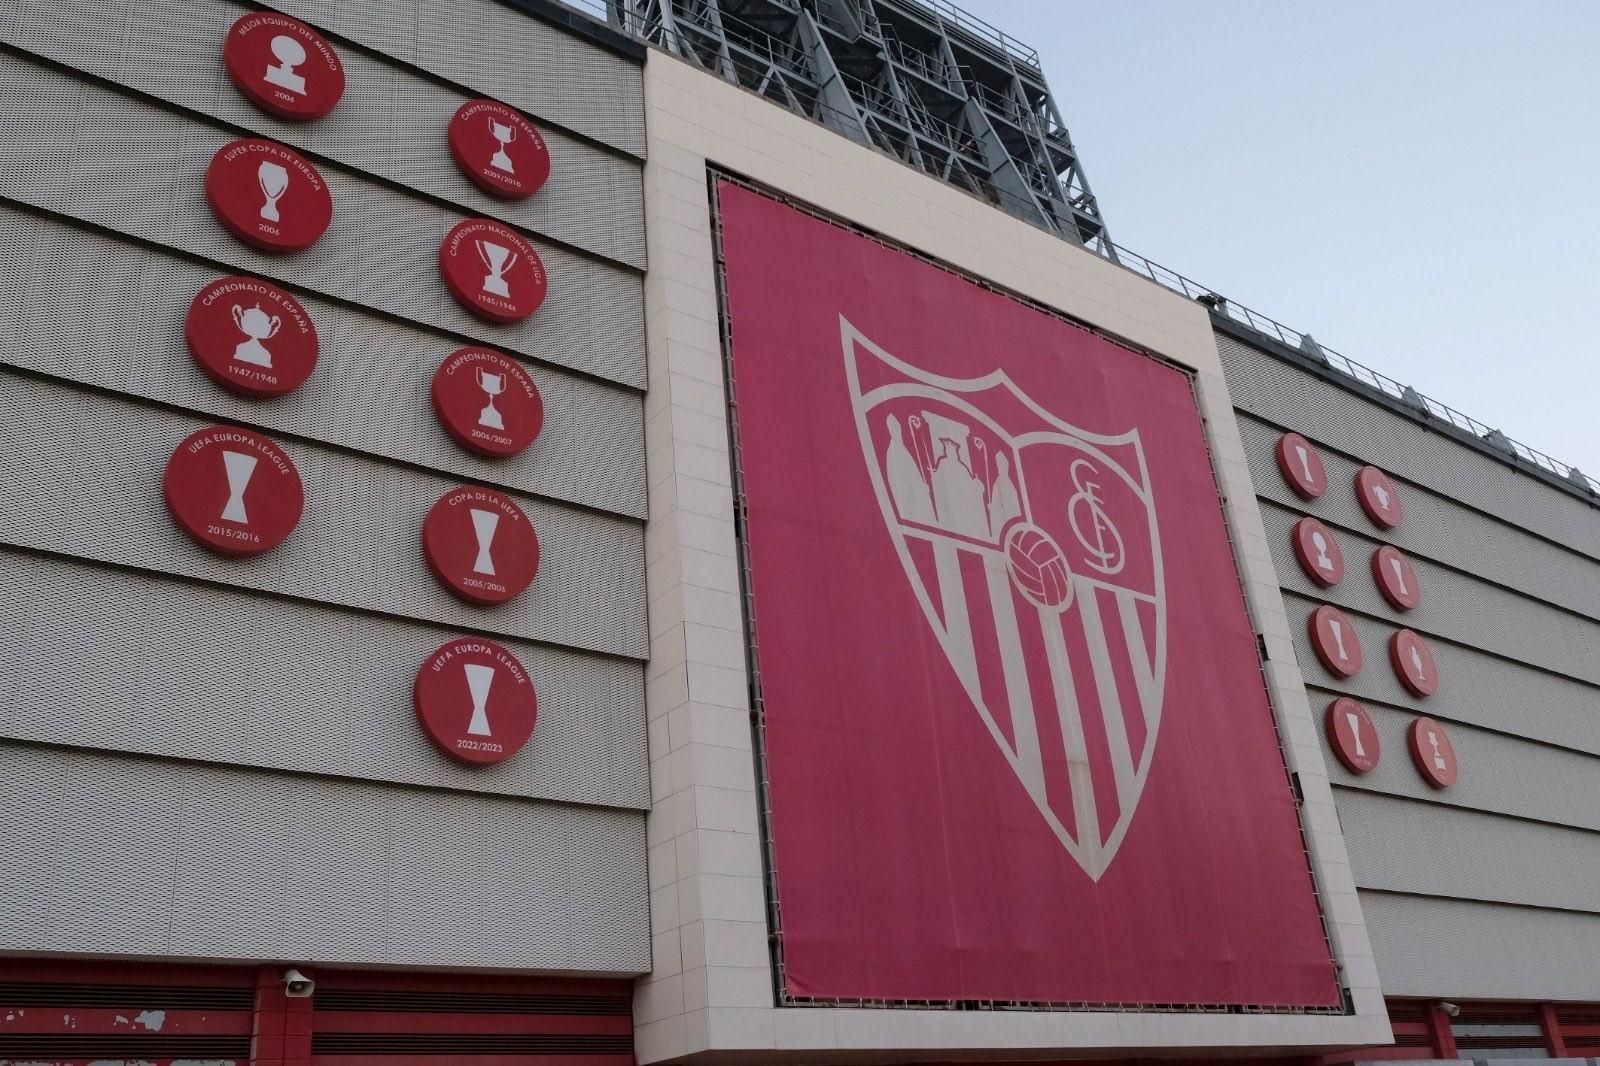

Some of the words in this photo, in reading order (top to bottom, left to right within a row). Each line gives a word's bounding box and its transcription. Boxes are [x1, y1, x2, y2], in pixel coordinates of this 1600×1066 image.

[262, 18, 296, 30] EQUIPO
[299, 28, 313, 40] DEL
[314, 41, 337, 71] MUNDO
[274, 91, 295, 103] 2006
[250, 145, 277, 155] COPA
[280, 152, 291, 161] DE
[294, 160, 321, 191] EUROPA
[259, 224, 280, 235] 2006
[450, 225, 486, 256] CAMPEONATO
[488, 226, 529, 253] NACIONAL
[527, 256, 536, 265] DE
[533, 266, 541, 284] LIGA
[203, 283, 267, 306] CAMPEONATO
[269, 291, 282, 302] DE
[478, 294, 516, 311] 1945/1946
[228, 365, 277, 384] 1947/1948
[447, 353, 497, 375] CAMPEONATO
[500, 360, 510, 369] DE
[189, 437, 212, 453] UEFA
[214, 433, 255, 446] EUROPA
[258, 443, 289, 475] LEAGUE
[449, 493, 473, 506] COPA
[489, 496, 498, 505] LA
[501, 502, 519, 520] UEFA
[208, 525, 259, 542] 2015/2016
[463, 578, 506, 592] 2005/2006
[432, 651, 453, 672] UEFA
[455, 645, 492, 655] EUROPA
[497, 653, 526, 684] LEAGUE
[457, 740, 502, 752] 2022/2023
